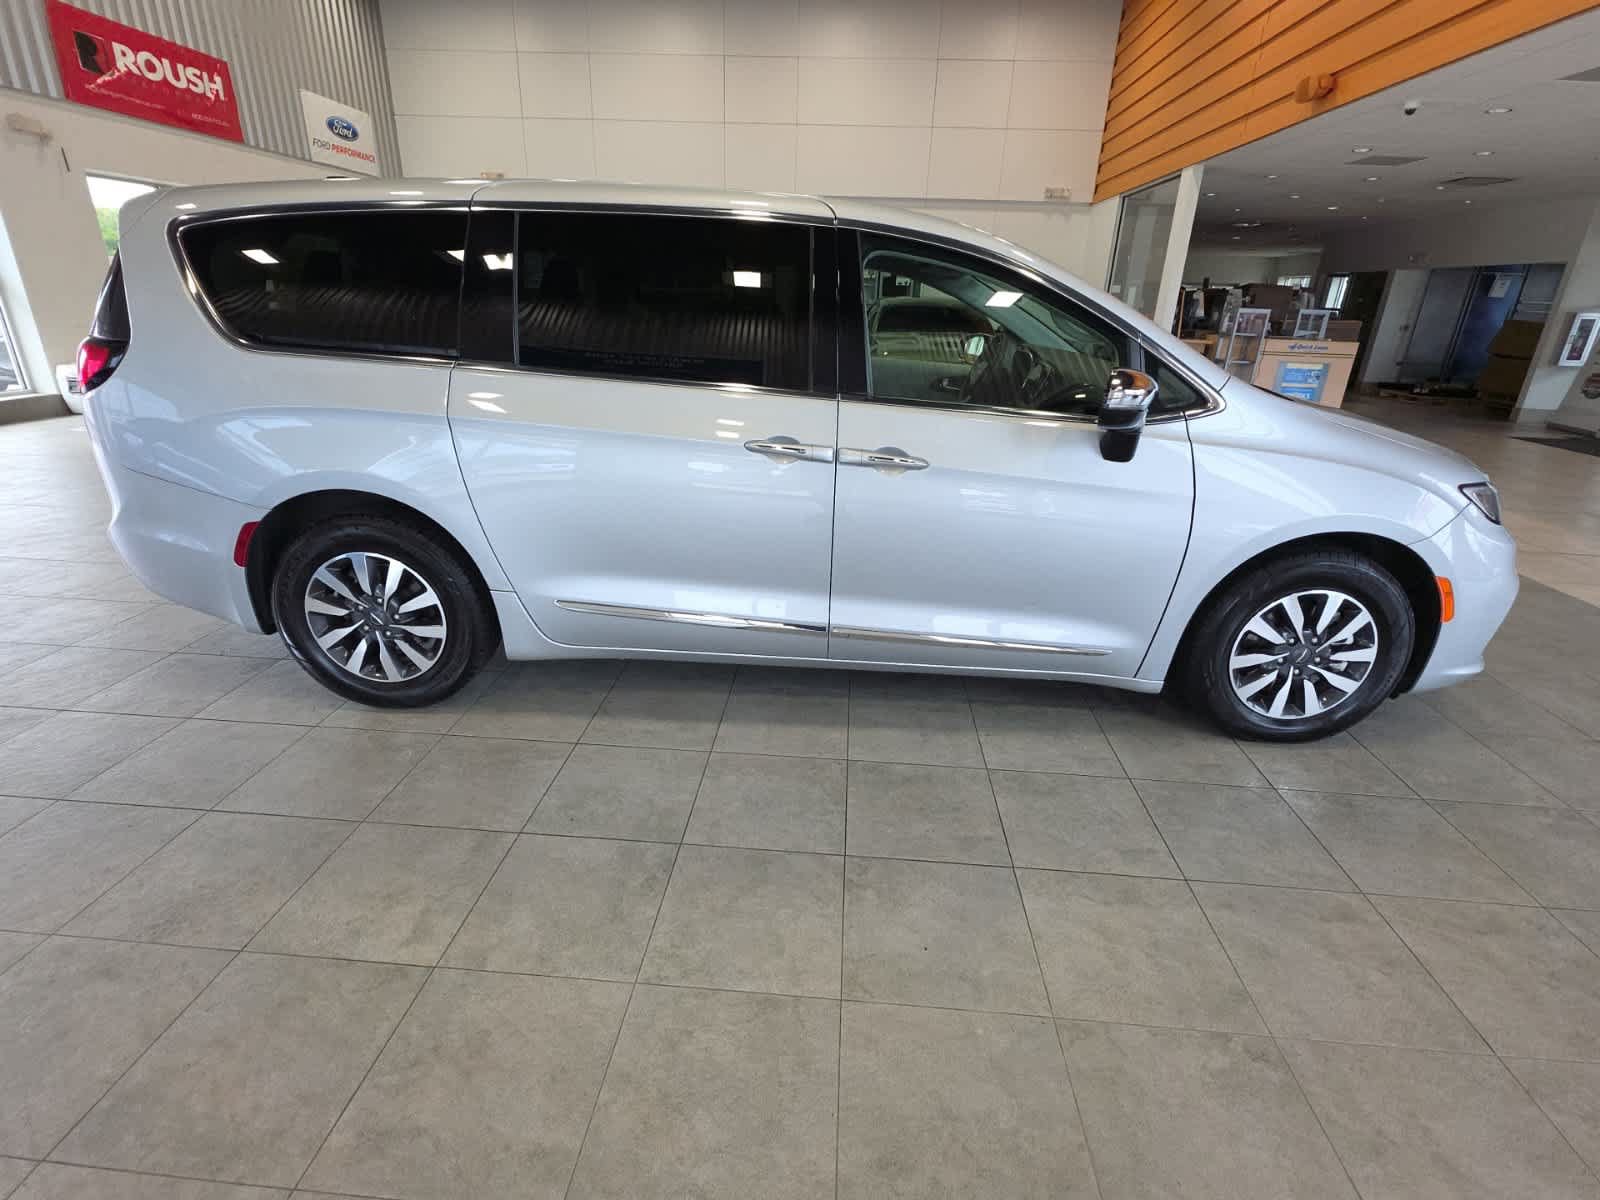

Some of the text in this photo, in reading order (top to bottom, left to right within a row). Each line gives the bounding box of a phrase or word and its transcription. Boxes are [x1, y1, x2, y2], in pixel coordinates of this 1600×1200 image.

[111, 41, 225, 101] ROUSH
[332, 119, 354, 138] Ford
[312, 137, 331, 151] FORD
